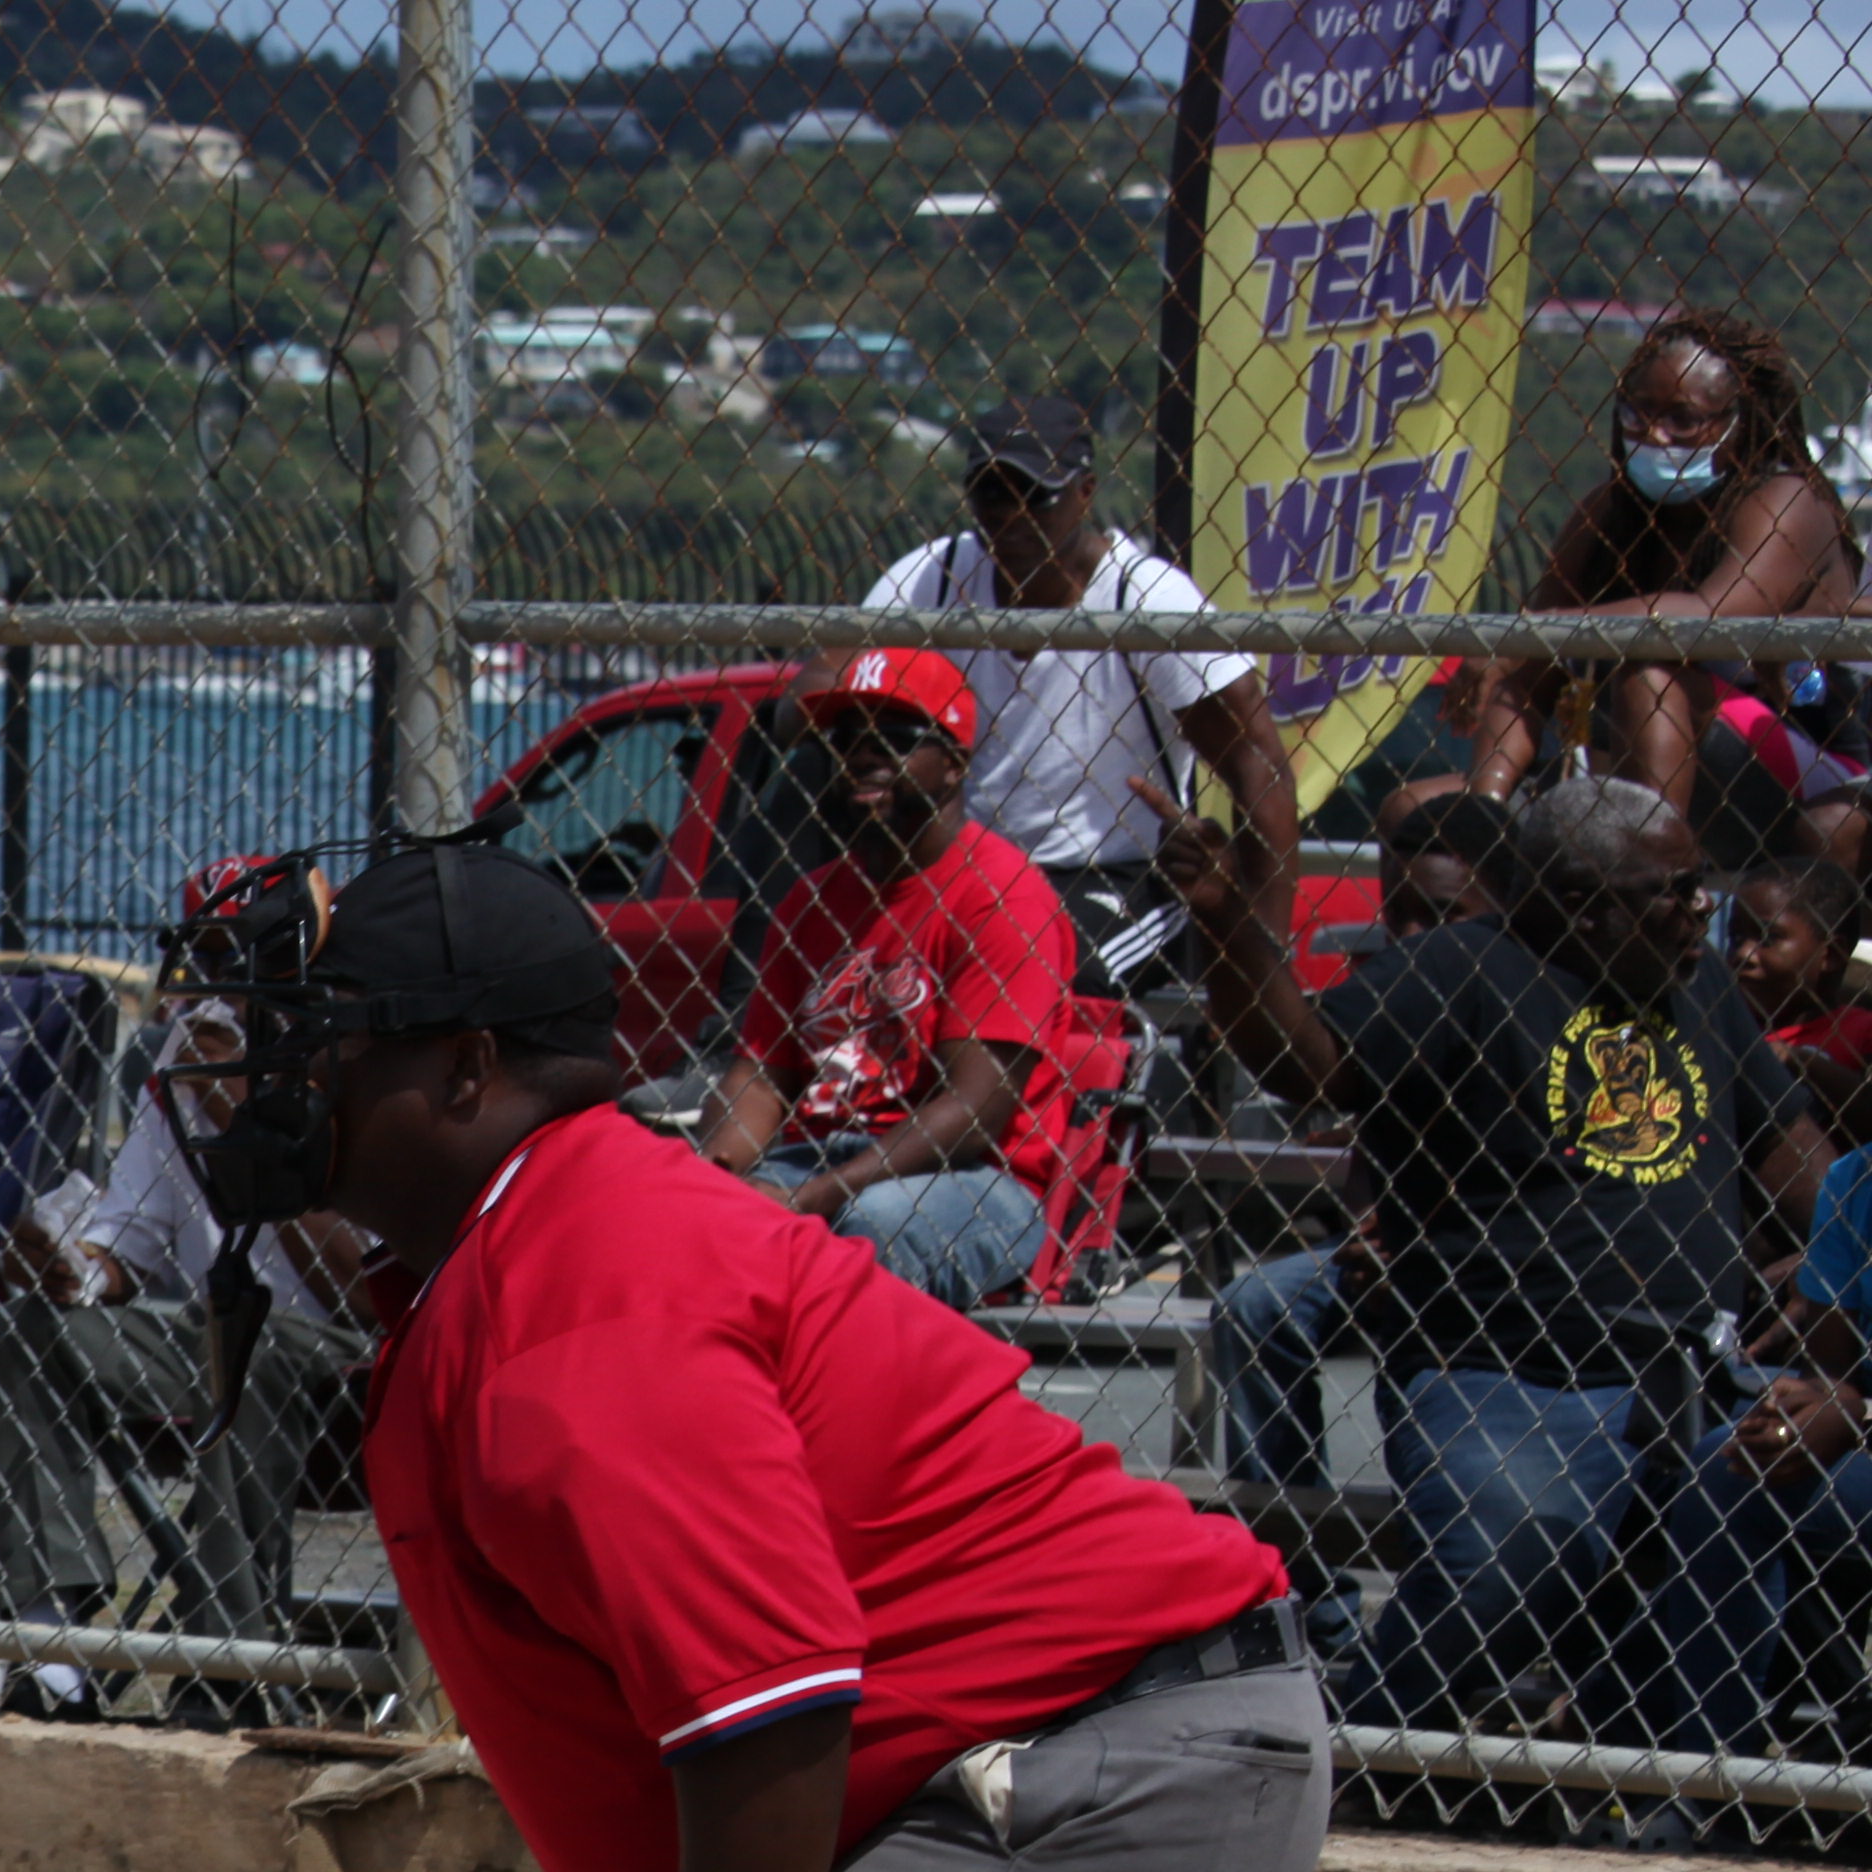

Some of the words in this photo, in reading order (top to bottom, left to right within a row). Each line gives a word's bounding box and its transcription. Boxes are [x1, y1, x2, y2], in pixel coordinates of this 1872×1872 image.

[1259, 43, 1504, 130] dspr.vi.gov
[1315, 3, 1383, 38] Visit
[1254, 191, 1501, 340] TEAM
[1302, 327, 1442, 459] UP
[1242, 446, 1475, 598] WITH
